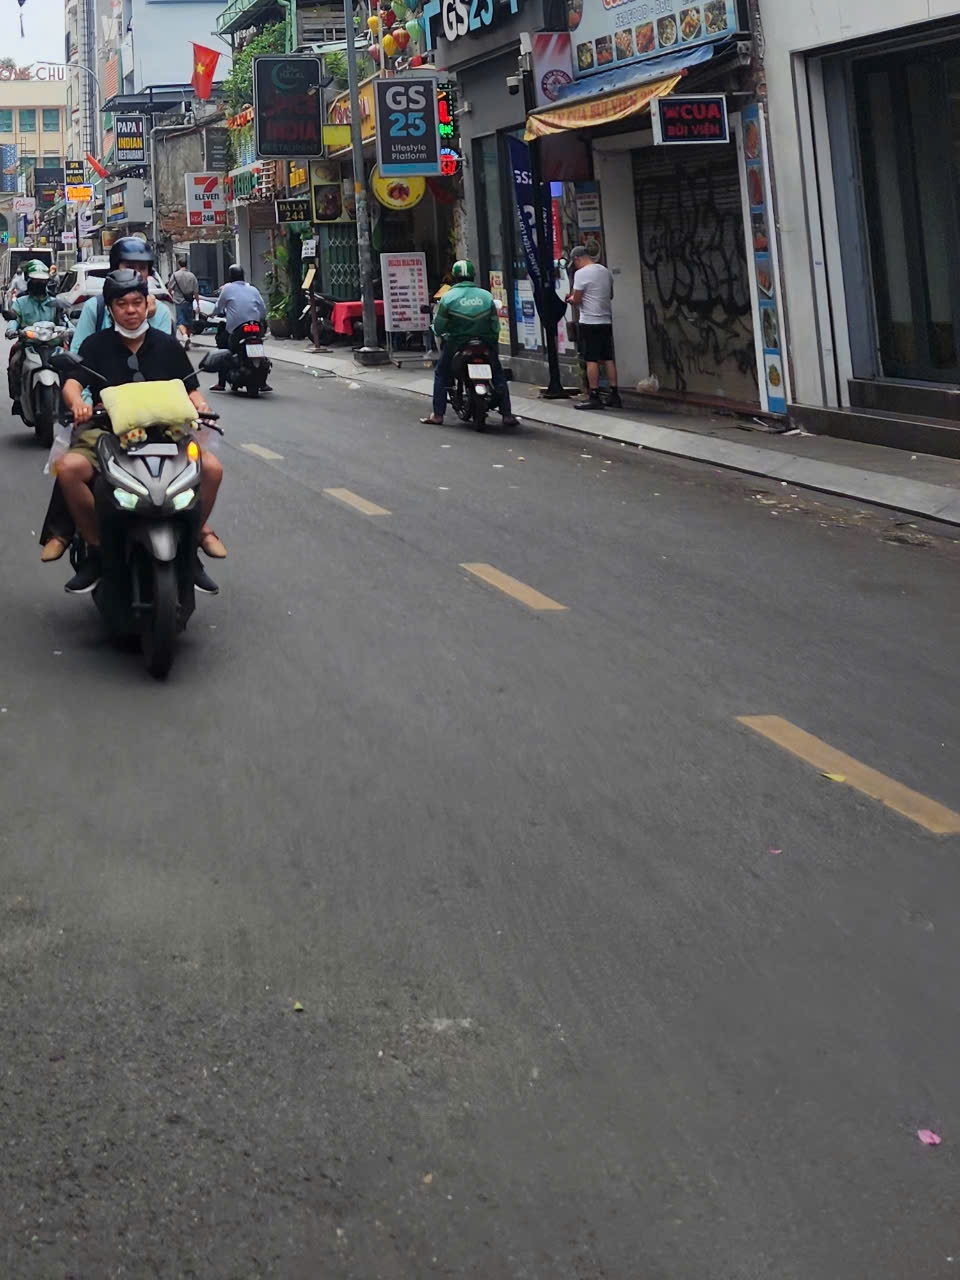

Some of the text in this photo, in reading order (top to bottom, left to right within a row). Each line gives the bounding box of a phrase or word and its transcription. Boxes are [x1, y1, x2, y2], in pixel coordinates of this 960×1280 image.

[36, 66, 64, 81] CHU
[385, 85, 427, 110] GS
[679, 103, 722, 120] CUA
[117, 121, 137, 133] PAPA
[389, 112, 427, 137] 25
[118, 137, 143, 149] INDIAN
[391, 143, 427, 154] Lifestyle
[391, 152, 427, 160] Platform
[285, 210, 305, 220] 244
[460, 297, 484, 306] Grab
